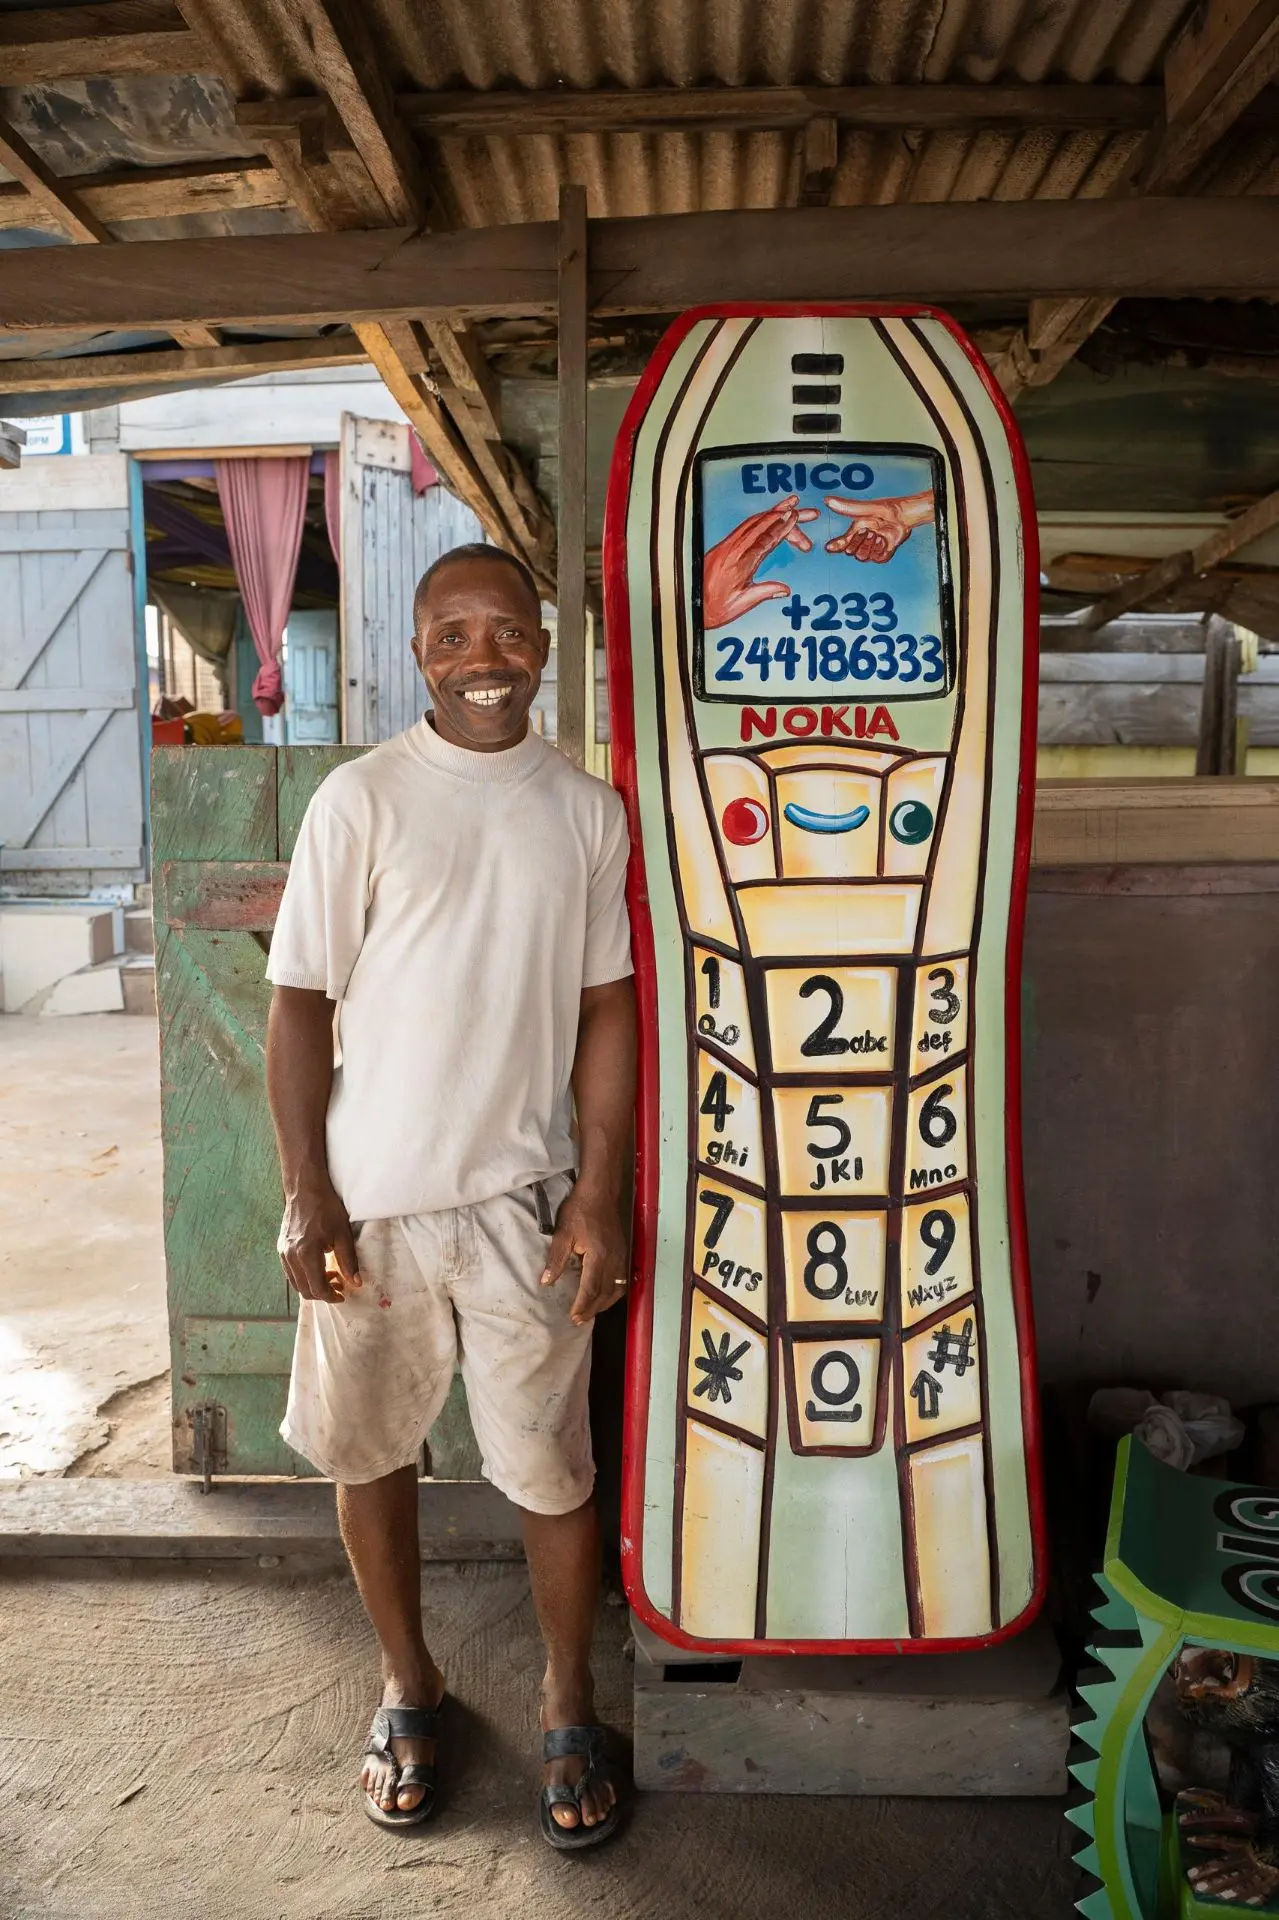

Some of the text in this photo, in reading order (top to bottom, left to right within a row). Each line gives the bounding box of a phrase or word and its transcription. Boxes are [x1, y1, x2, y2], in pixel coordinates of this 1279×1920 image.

[740, 463, 875, 495] ERICO
[782, 592, 899, 632] +233
[715, 635, 944, 682] 244186333
[740, 705, 900, 742] NOKIA
[701, 956, 720, 1010] 1
[928, 967, 960, 1024] 3
[917, 1031, 953, 1053] def
[700, 1070, 735, 1133] 4
[806, 1094, 852, 1159] 5
[918, 1083, 957, 1148] 6
[706, 1140, 749, 1168] ghi
[699, 1190, 735, 1250] 7
[919, 1209, 957, 1276] 9
[804, 1221, 849, 1301] 8
[810, 1351, 861, 1406] 0
